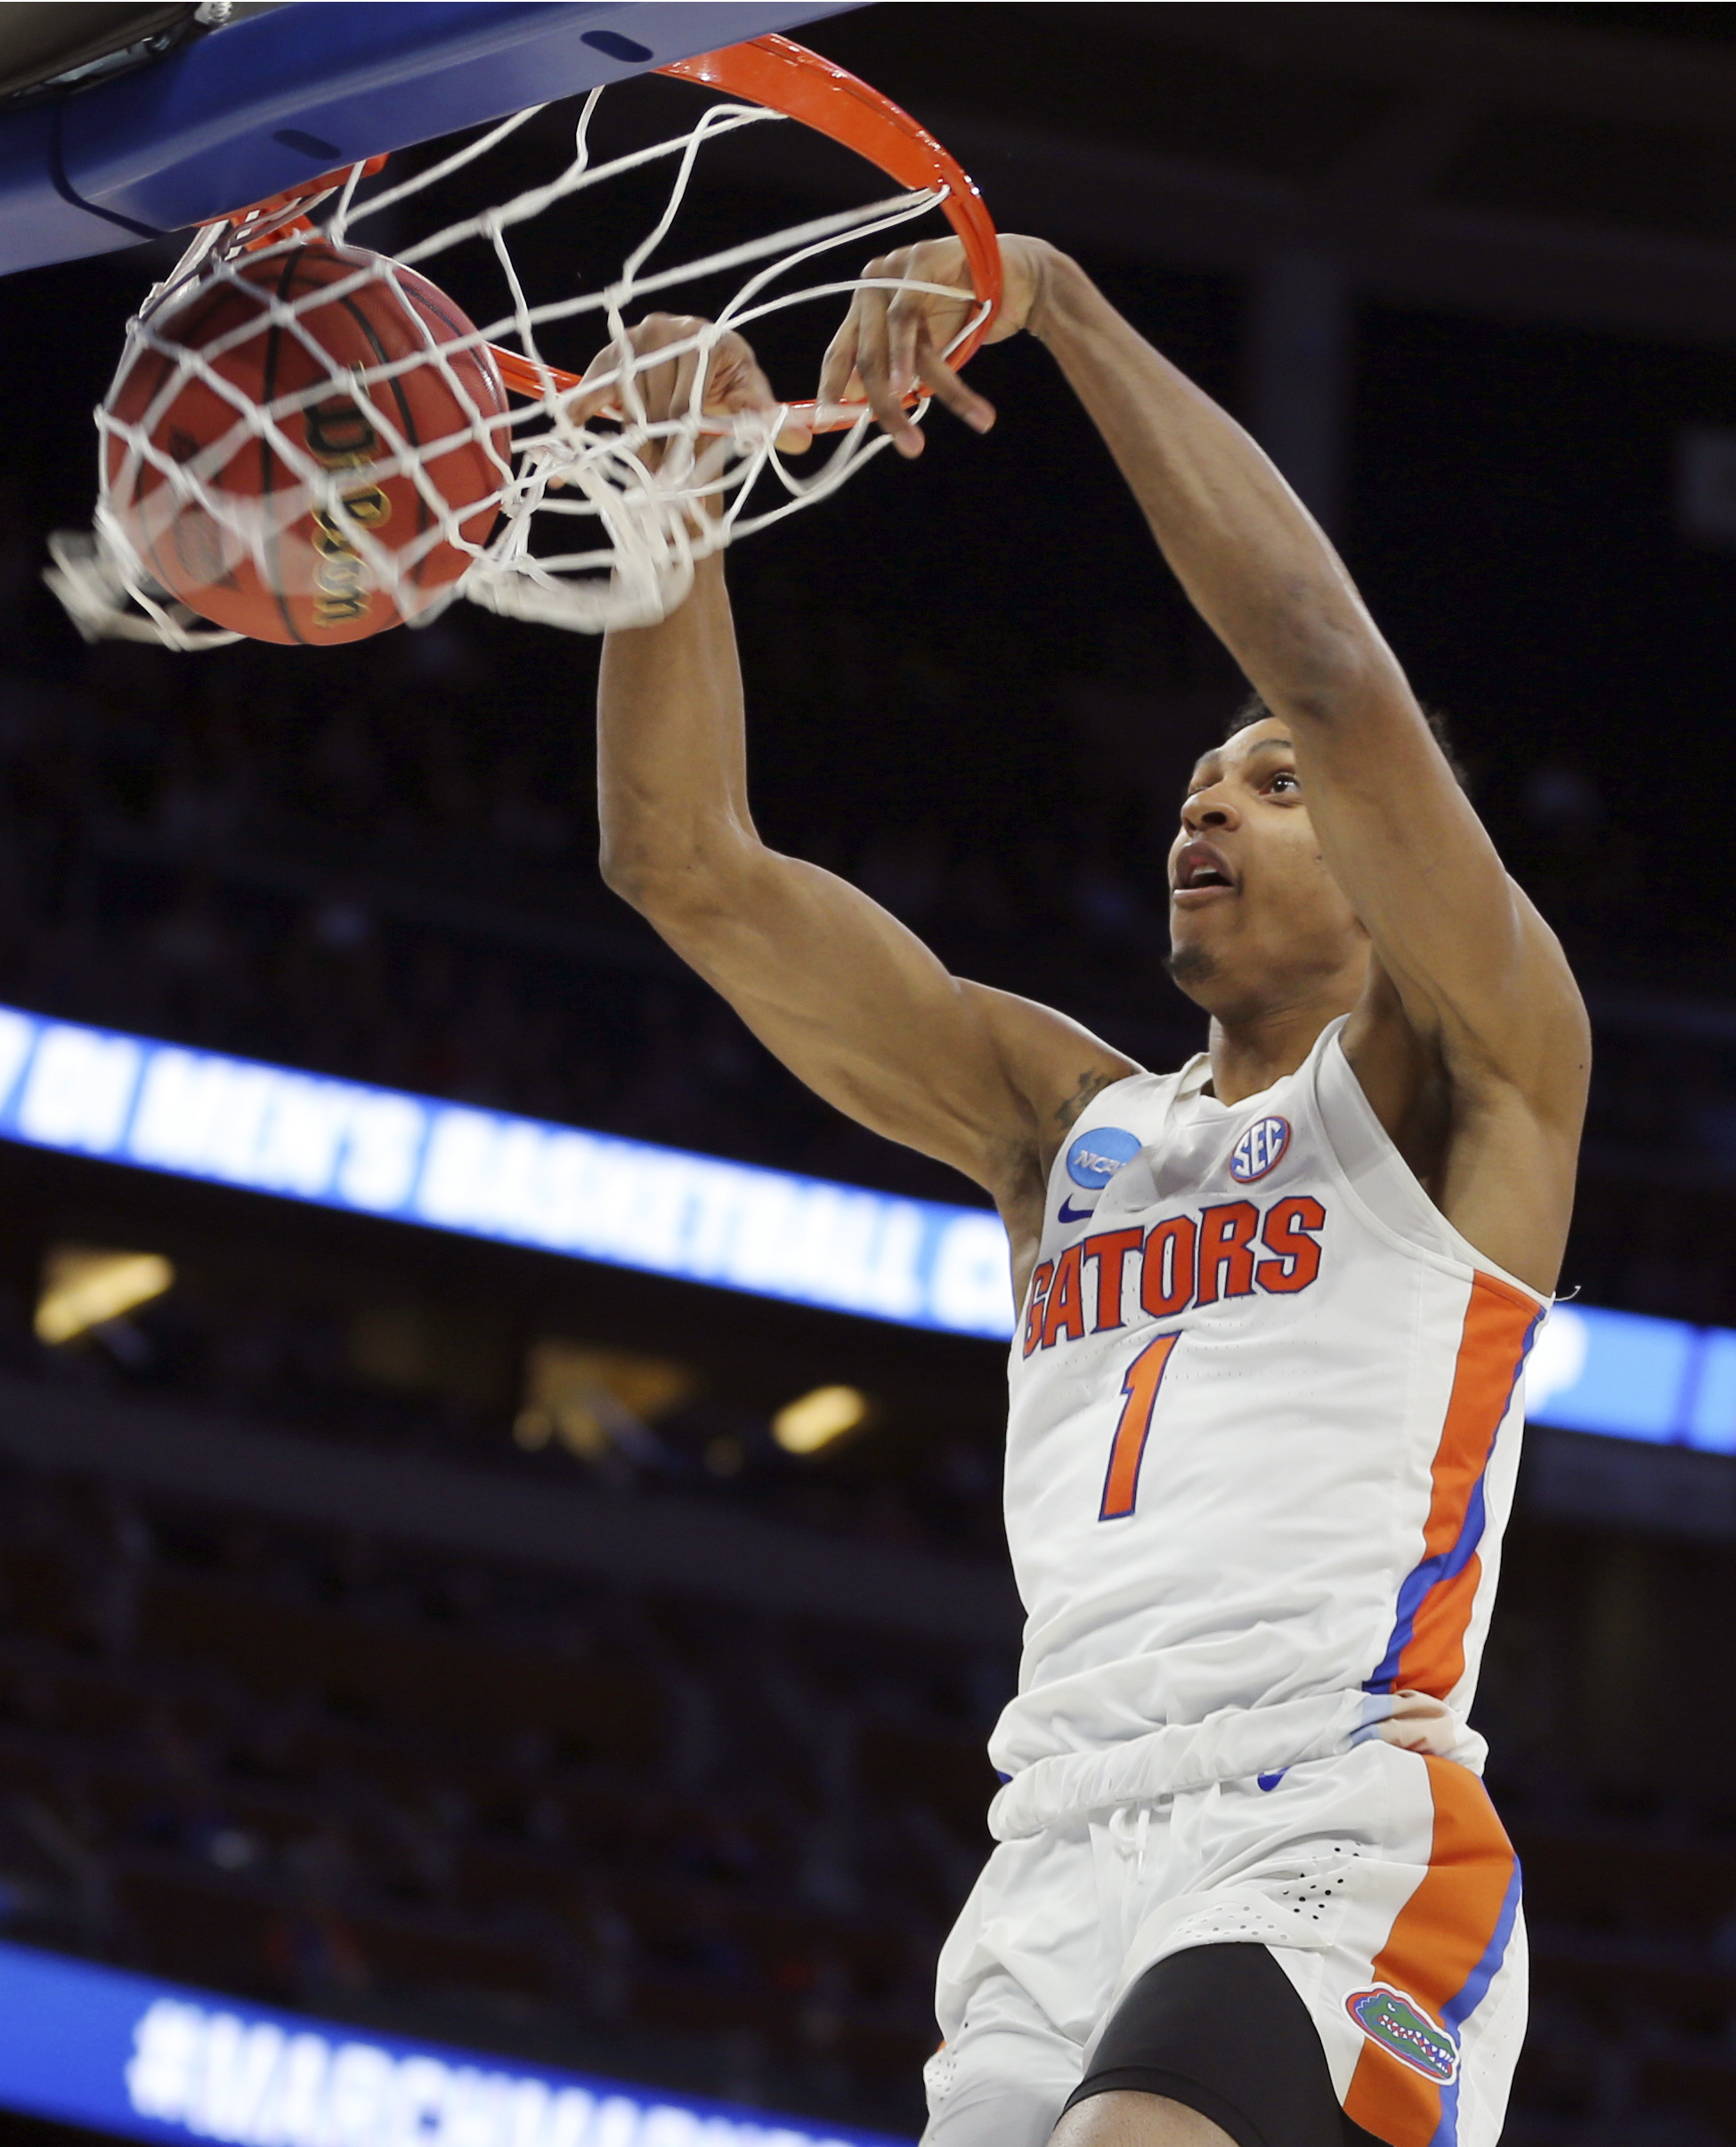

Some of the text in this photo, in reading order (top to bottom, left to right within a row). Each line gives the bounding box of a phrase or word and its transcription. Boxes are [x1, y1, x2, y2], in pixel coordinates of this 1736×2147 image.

[1234, 1119, 1283, 1178] SEC
[1023, 1195, 1326, 1361] GATORS
[1098, 1329, 1184, 1522] 1
